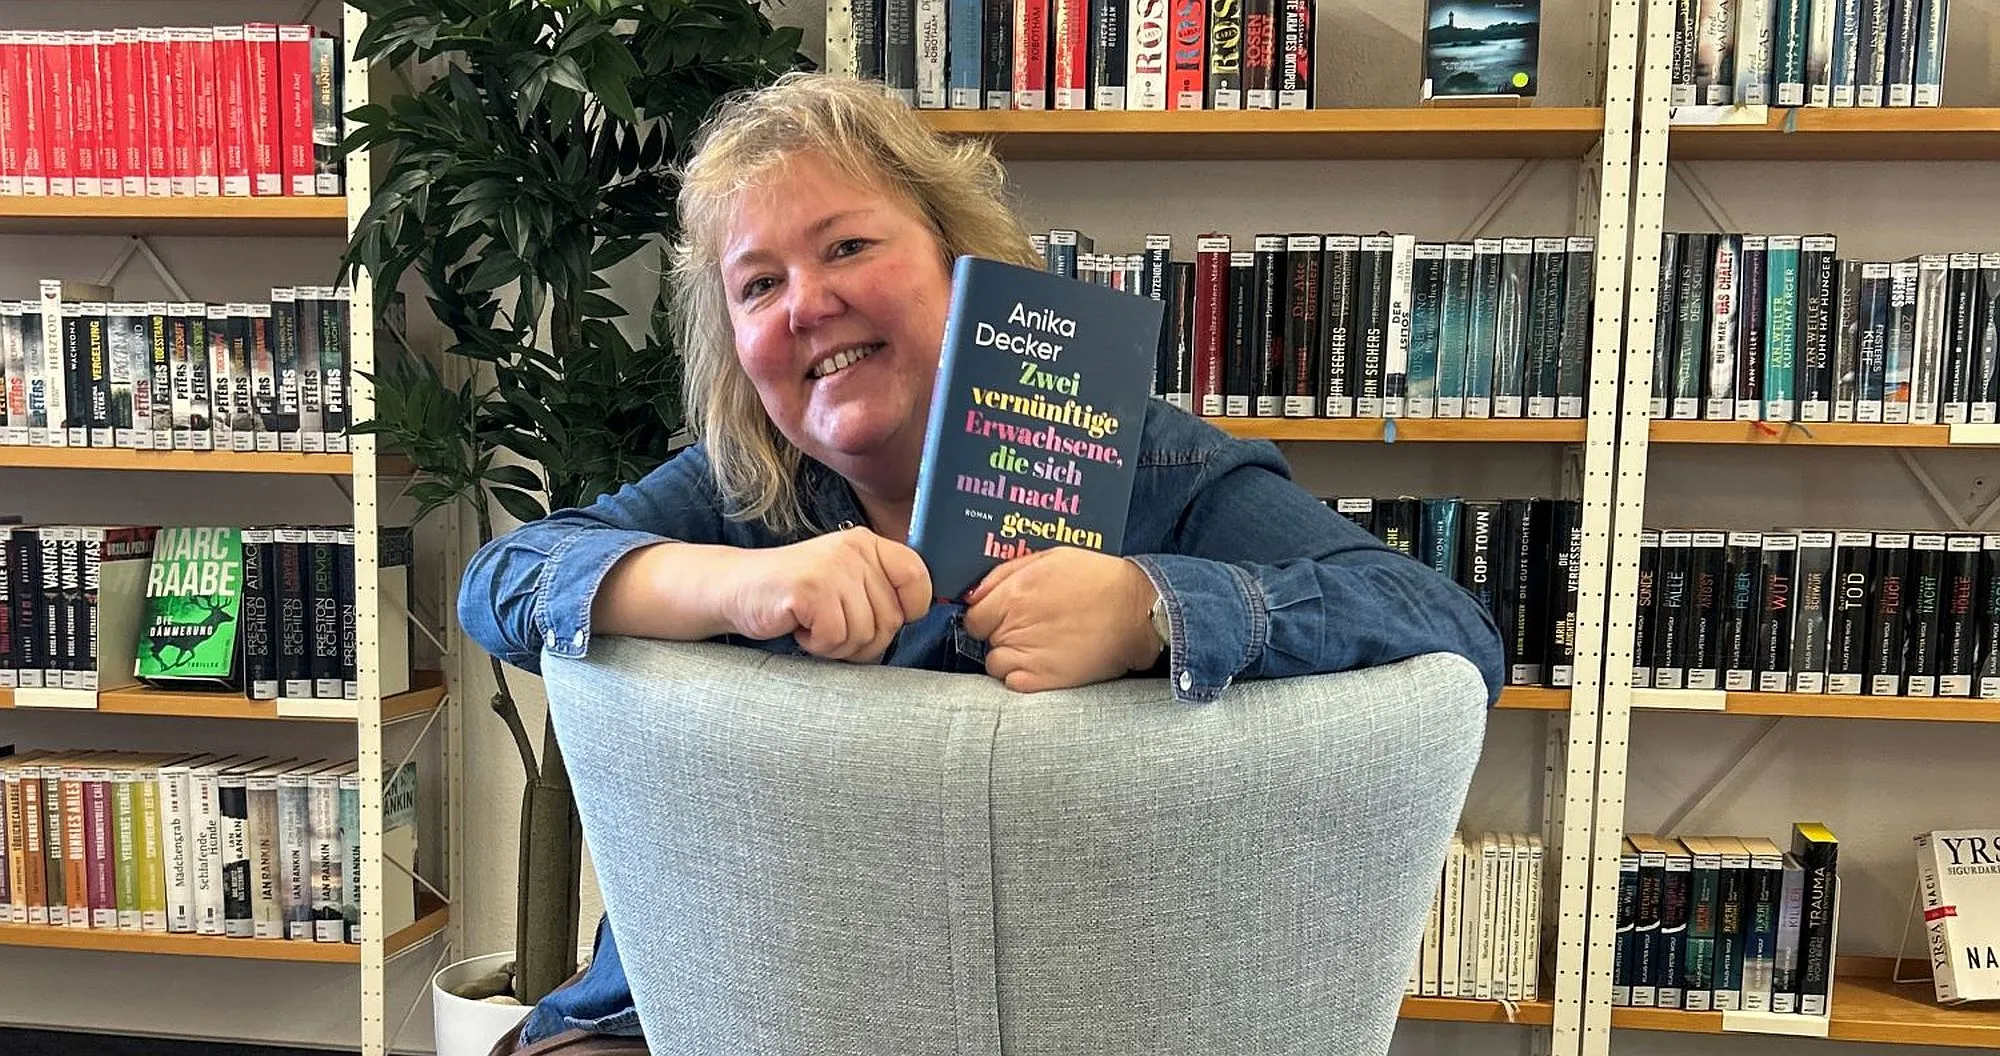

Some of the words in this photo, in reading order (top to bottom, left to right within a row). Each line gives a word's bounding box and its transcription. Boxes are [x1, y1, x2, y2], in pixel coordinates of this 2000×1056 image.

[931, 15, 939, 63] ROBOTHAM
[1031, 6, 1041, 61] ROBOTHAM
[1108, 6, 1117, 47] ROBOTHAM
[1286, 12, 1298, 32] ARM
[1717, 0, 1729, 52] VARGA
[1286, 34, 1297, 52] DES
[1682, 38, 1693, 84] MAKELLO
[1284, 54, 1297, 90] OKTOPUS
[1294, 263, 1305, 291] Akte
[1428, 260, 1439, 281] Erbe
[1719, 251, 1733, 290] CHALET
[1821, 256, 1831, 306] HUNGER
[1008, 302, 1078, 339] Anika
[1392, 301, 1402, 324] DER
[1416, 292, 1427, 351] SELLANO
[1534, 288, 1546, 345] SELLANO
[1691, 292, 1701, 322] DEINE
[1719, 294, 1730, 315] DAS
[1773, 297, 1783, 342] WEILER
[1785, 309, 1793, 330] HAT
[1807, 297, 1819, 343] WEILER
[1820, 309, 1829, 330] HAT
[48, 314, 59, 370] HERZTOD
[69, 321, 78, 370] WACHKOMA
[153, 316, 165, 363] TODESSTRAND
[976, 322, 1063, 362] Decker
[1399, 312, 1410, 350] SOLIST
[1717, 321, 1727, 342] WARE
[1749, 331, 1757, 366] WEILER
[1862, 330, 1875, 366] KLIFF
[90, 321, 102, 381] VERGELTUNG
[1331, 327, 1346, 374] SEGHERS
[1366, 329, 1380, 375] SEGHERS
[1532, 349, 1543, 376] LUIS
[1716, 344, 1725, 364] RUTH
[1772, 348, 1782, 368] JAN
[1784, 334, 1792, 369] KÜHN
[1818, 334, 1827, 369] KÜHN
[11, 377, 24, 416] PETERS
[32, 380, 44, 416] PETERS
[156, 364, 169, 402] PETERS
[177, 364, 189, 400] PETERS
[194, 365, 206, 400] PETERS
[217, 377, 229, 413] PETERS
[236, 377, 248, 414] PETERS
[256, 377, 271, 413] PETERS
[283, 369, 297, 413] PETERS
[305, 370, 319, 413] PETERS
[328, 369, 343, 413] PETERS
[1018, 362, 1082, 397] Zwei
[1330, 379, 1344, 397] JAN
[1364, 379, 1378, 399] JAN
[137, 380, 150, 417] PETERS
[972, 387, 1119, 439] vernünftige
[964, 410, 1124, 469] Erwachsene,
[989, 446, 1029, 474] die
[1032, 460, 1083, 486] sich
[956, 472, 1006, 498] mal
[1009, 484, 1082, 516] nackt
[964, 508, 994, 522] ROMAN
[1000, 512, 1103, 549] gesehen
[1476, 511, 1490, 552] TOWN
[152, 526, 230, 561] MARC
[984, 532, 1036, 560] hab
[1436, 538, 1444, 557] VON
[1521, 515, 1531, 556] TOCHTER
[42, 540, 59, 589] VANITAS
[62, 541, 78, 590] VANITAS
[84, 541, 99, 590] VANITAS
[247, 543, 258, 590] ATTAC
[1474, 555, 1488, 583] COP
[1520, 558, 1528, 581] GUTE
[1558, 552, 1569, 567] DIE
[1567, 526, 1582, 593] VERGESSENE
[146, 562, 239, 598] RAABE
[1519, 584, 1528, 599] DIE
[1639, 570, 1653, 607] SONDE
[1669, 571, 1684, 608] FALLE
[1736, 572, 1751, 609] FEUER
[1772, 573, 1789, 610] WUT
[1845, 573, 1865, 610] TOD
[1886, 576, 1901, 614] FLUCH
[1923, 576, 1937, 613] NACHT
[1957, 576, 1971, 614] HÖLLE
[150, 625, 213, 637] DÄMMERUNG
[156, 616, 173, 625] DIE
[247, 596, 257, 656] PRESTON
[283, 598, 294, 656] PRESTON
[316, 597, 327, 657] PRESTON
[343, 604, 354, 666] PRESTON
[1555, 619, 1566, 644] KARIN
[1564, 611, 1576, 656] SLAUGHTER
[48, 778, 57, 791] BLE
[66, 783, 81, 813] ARLES
[68, 814, 83, 860] DUNKLES
[172, 818, 186, 887] Mädchengrab
[208, 820, 219, 855] Hunde
[235, 820, 243, 859] RANKIN
[1941, 836, 2000, 865] YRS
[198, 832, 209, 891] Schlafende
[260, 839, 272, 880] RANKIN
[292, 850, 301, 883] RANKIN
[320, 843, 331, 882] RANKIN
[1948, 866, 2000, 875] SIGURDAR
[262, 882, 273, 900] IAN
[293, 885, 301, 900] IAN
[321, 883, 331, 901] IAN
[1809, 867, 1825, 928] TRAUMA
[1930, 924, 1946, 970] YRSA
[1966, 946, 1999, 969] NA
